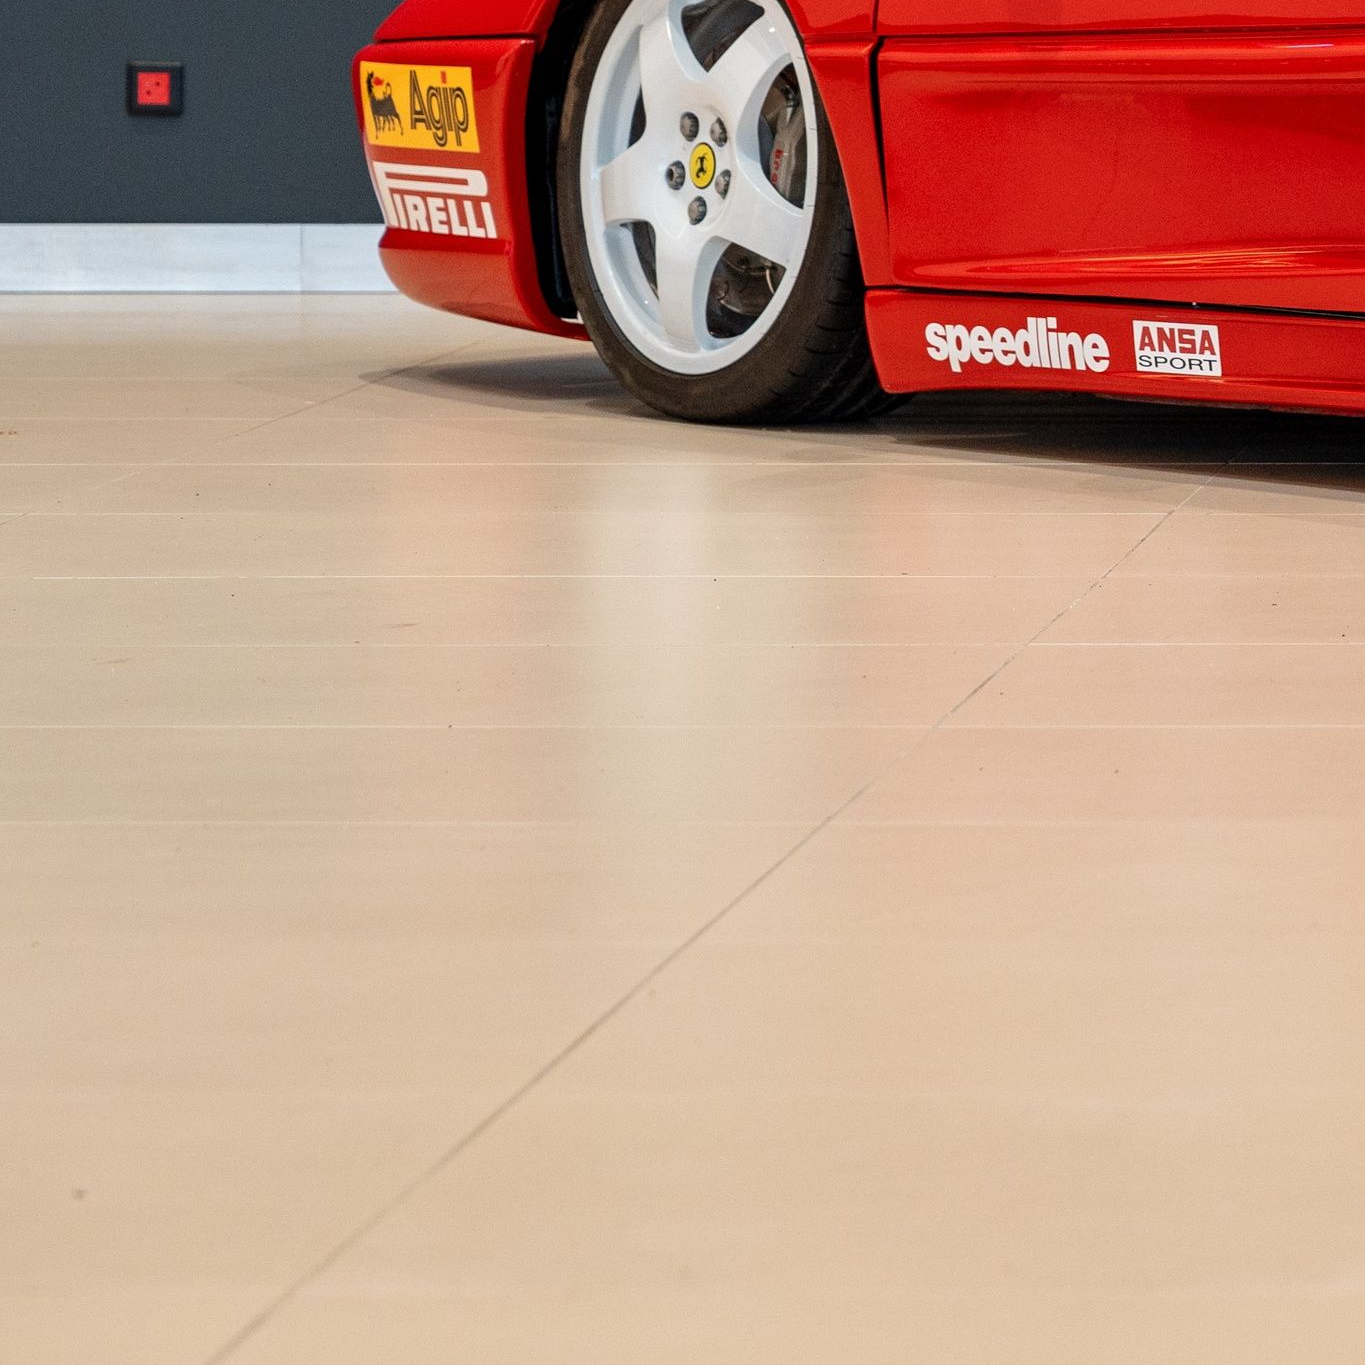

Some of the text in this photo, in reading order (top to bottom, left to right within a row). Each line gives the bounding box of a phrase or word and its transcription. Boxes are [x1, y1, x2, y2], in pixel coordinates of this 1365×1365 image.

[409, 69, 470, 148] Agip
[372, 160, 498, 239] PIRELLI
[925, 316, 1111, 373] speedline
[1137, 354, 1218, 372] SPORT
[1138, 325, 1217, 356] ANSA
